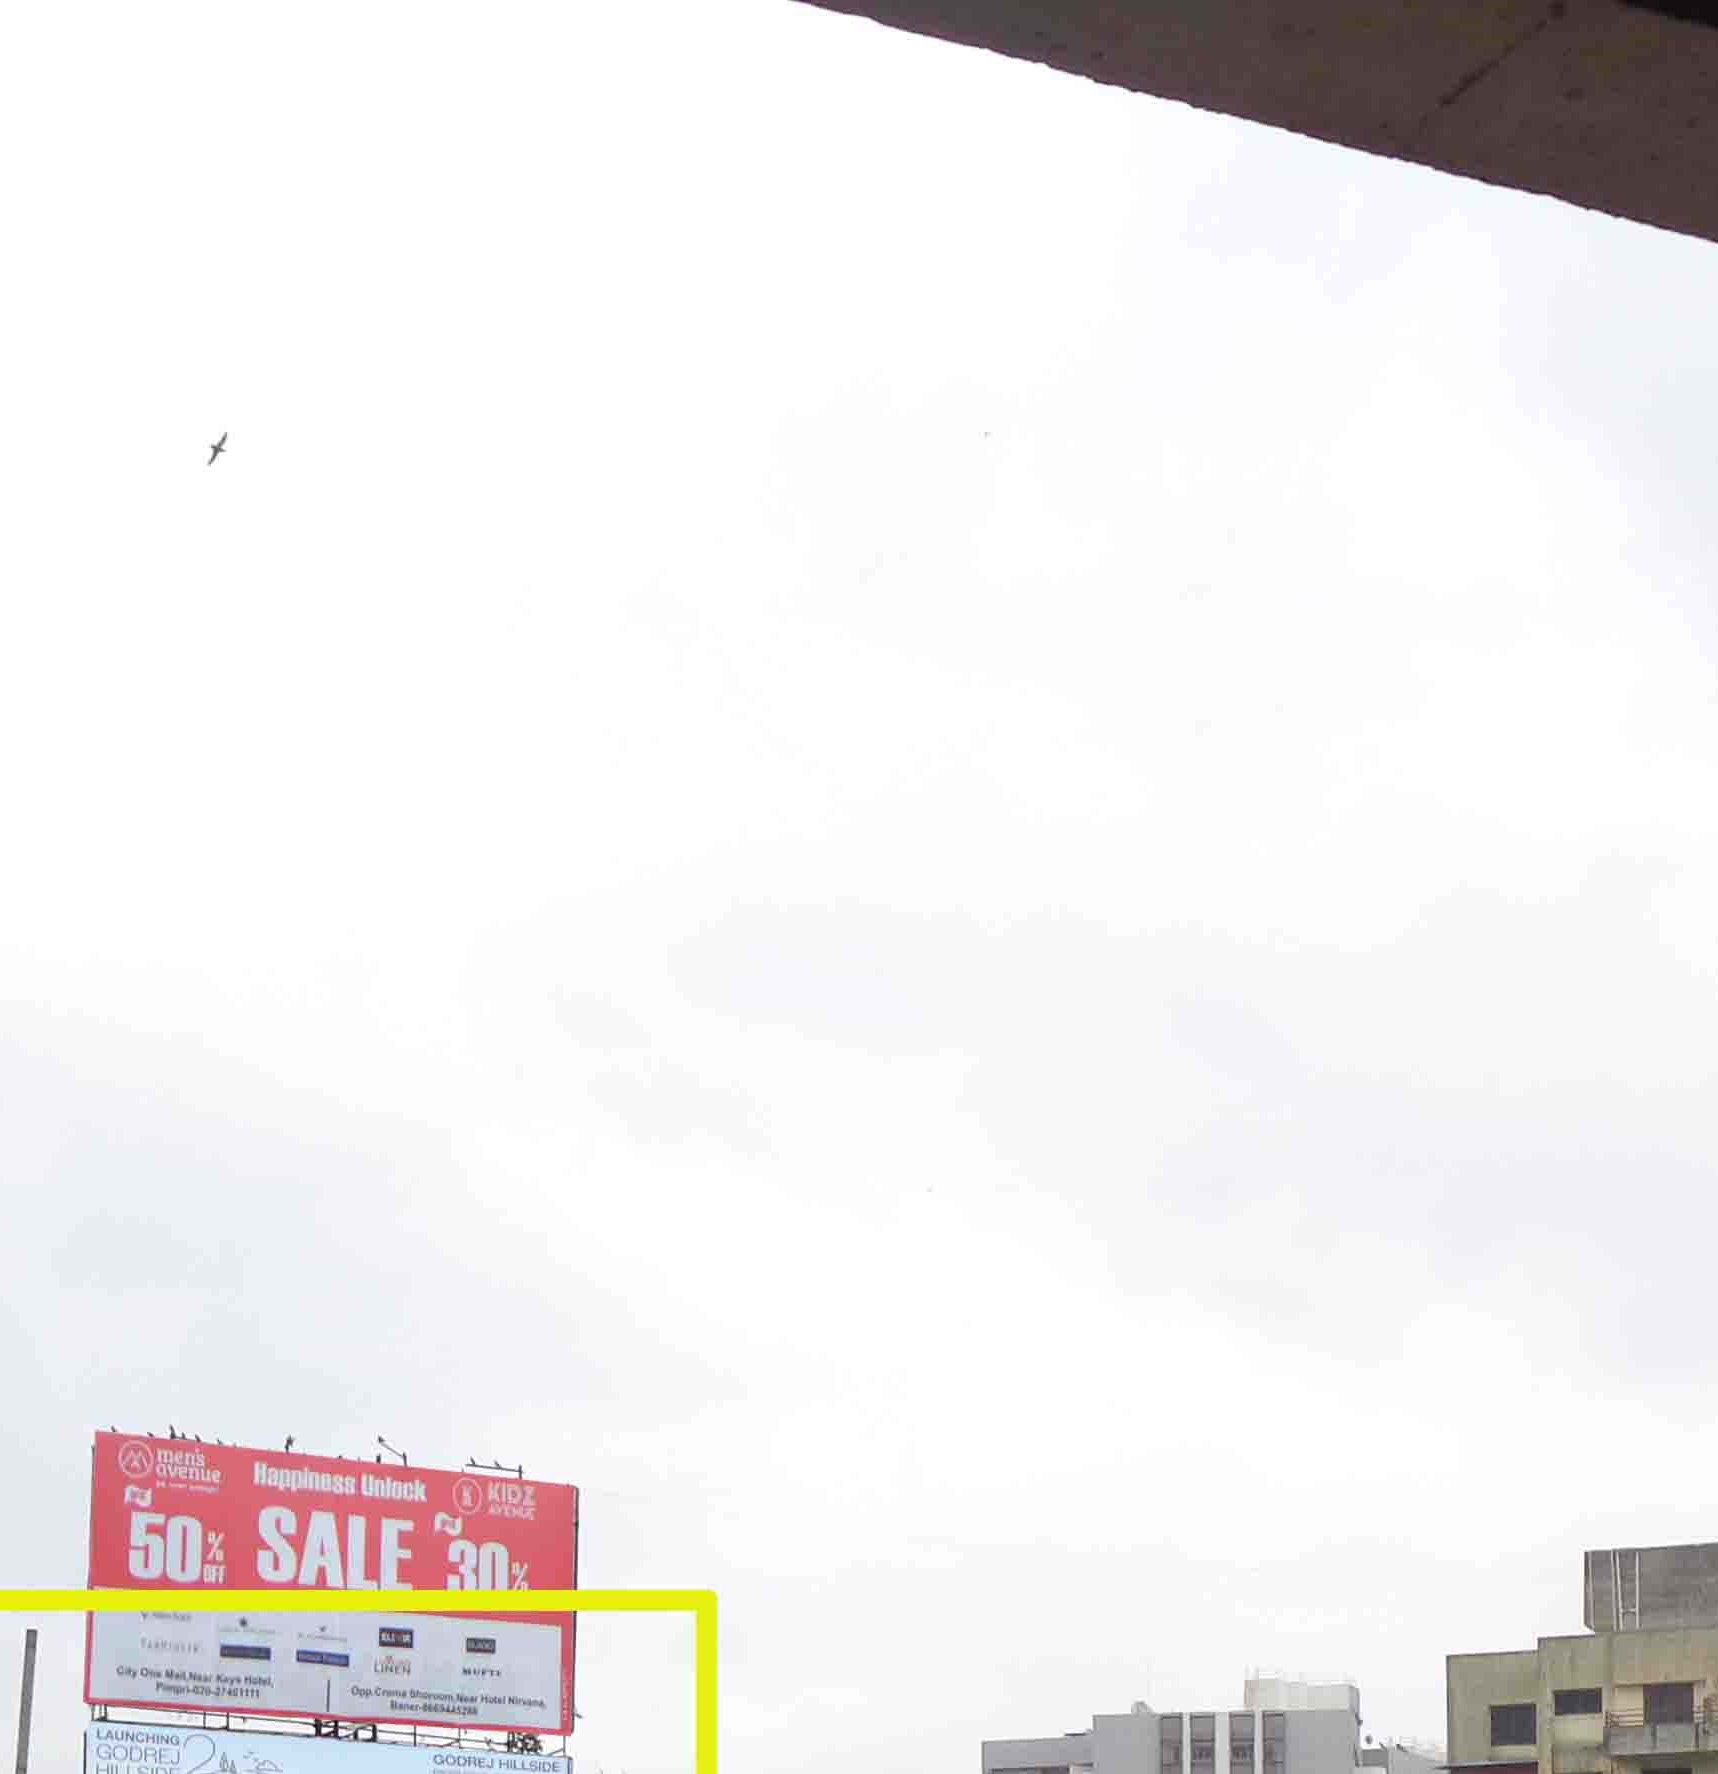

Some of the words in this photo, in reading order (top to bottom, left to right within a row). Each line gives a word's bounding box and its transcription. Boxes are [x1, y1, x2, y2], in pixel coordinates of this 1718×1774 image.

[253, 1461, 356, 1496] Happiness
[361, 1474, 427, 1502] Unlock
[256, 1505, 414, 1590] SALE
[116, 1665, 137, 1680] City
[96, 1730, 180, 1746] LAUNCHING
[96, 1744, 180, 1765] GODREJ
[433, 1754, 494, 1770] GODREJ
[499, 1759, 561, 1773] HILLSIDE
